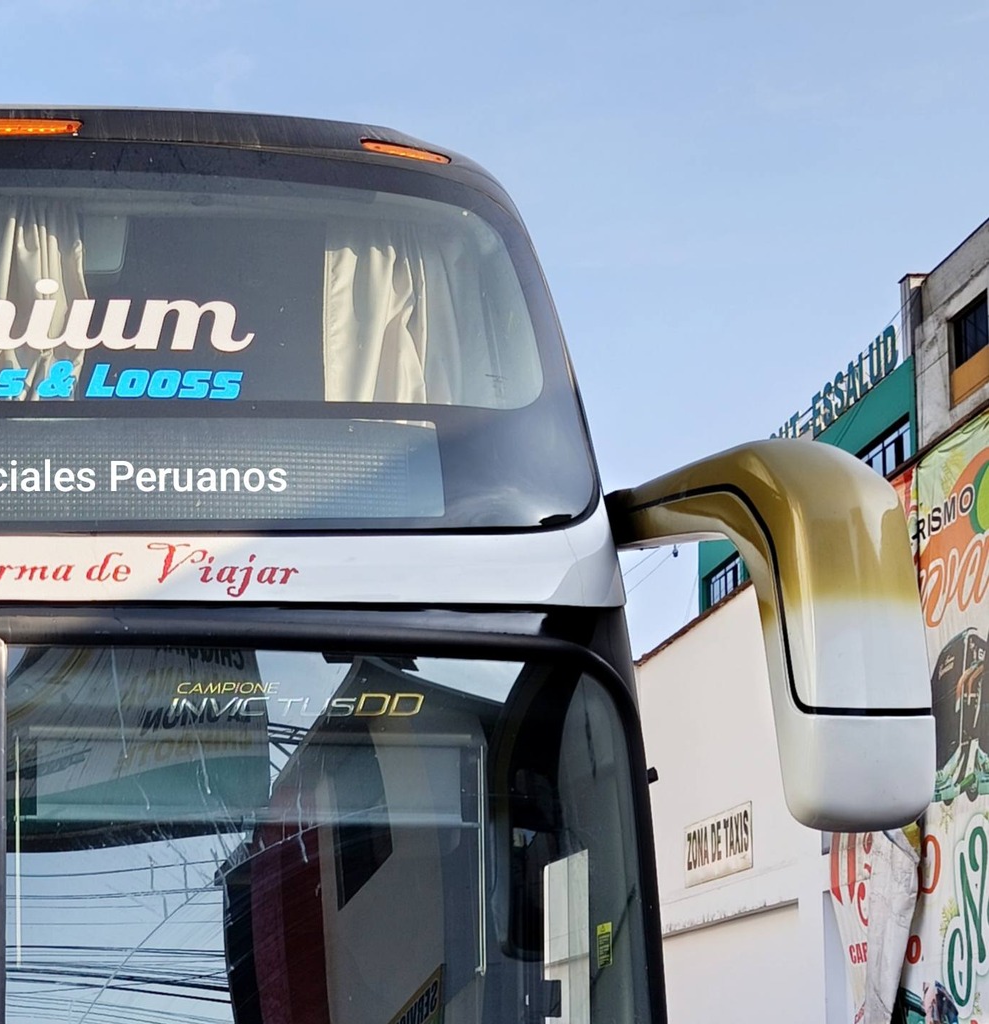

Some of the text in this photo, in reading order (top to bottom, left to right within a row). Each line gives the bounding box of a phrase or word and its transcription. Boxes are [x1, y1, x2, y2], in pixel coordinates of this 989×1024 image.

[36, 360, 76, 398] &
[85, 551, 131, 583] de
[147, 542, 299, 598] Viajar
[176, 681, 280, 694] CAMPIONE
[687, 809, 749, 870] ZONA DE TAXIS
